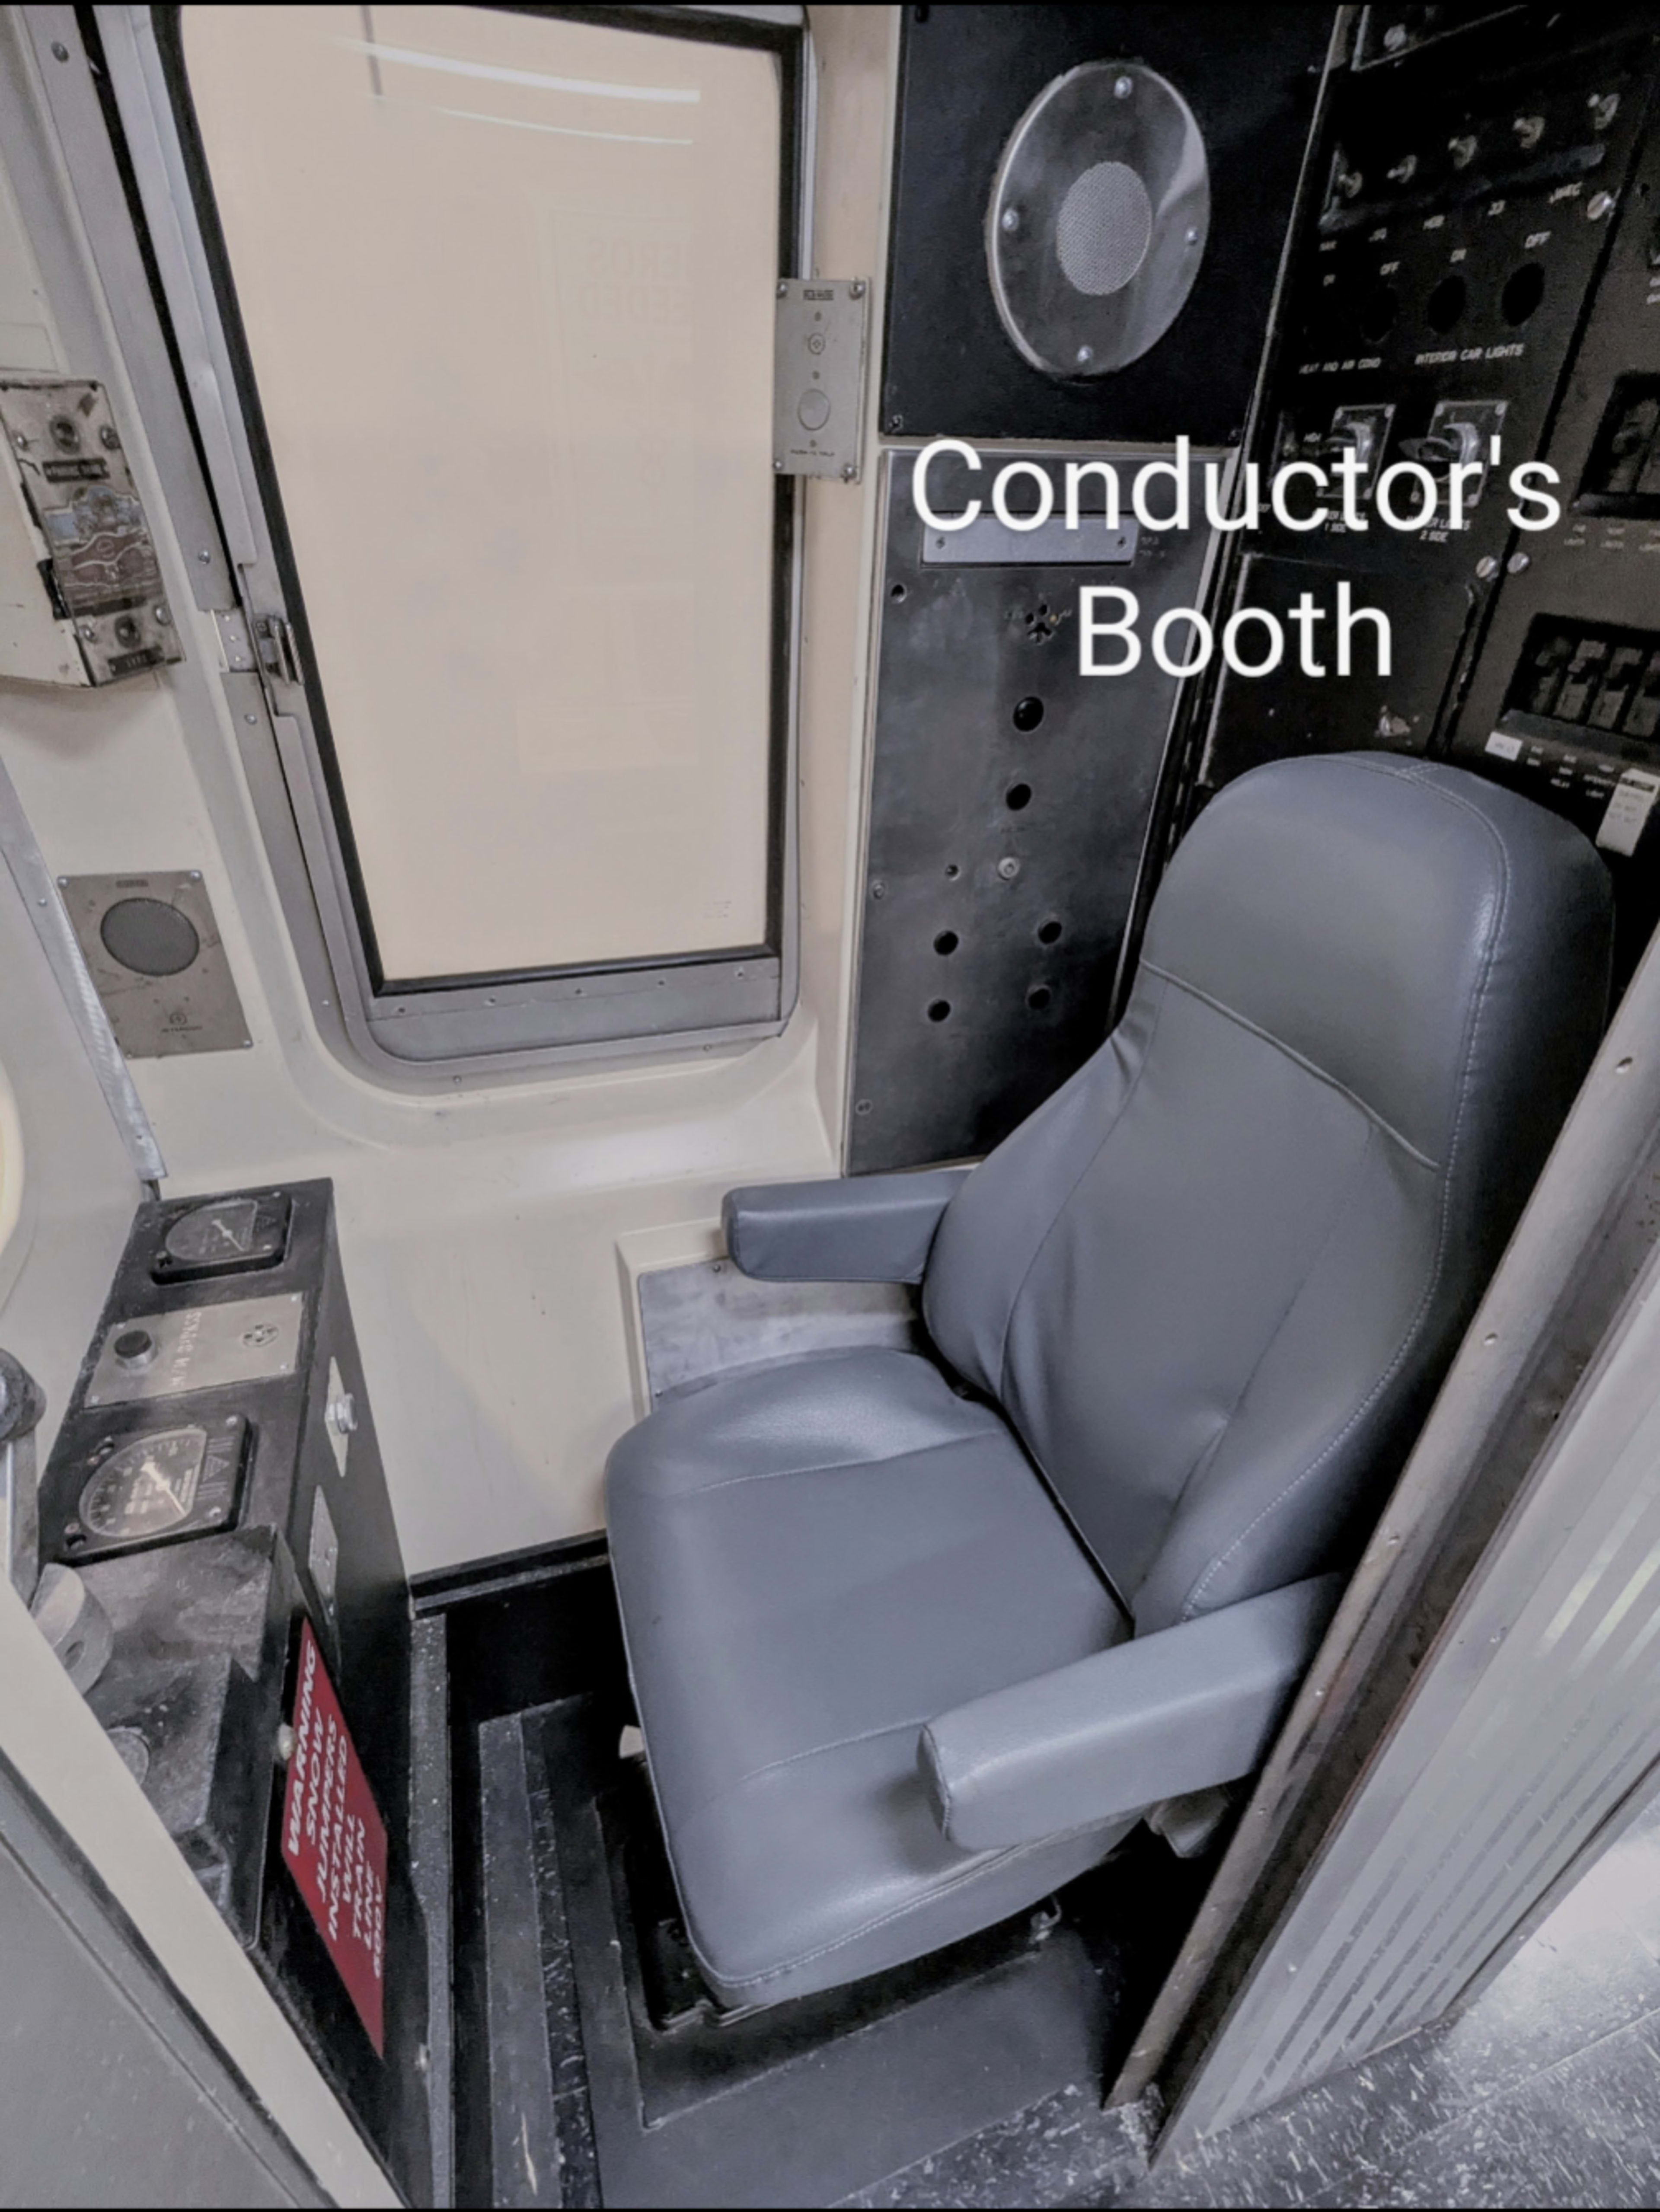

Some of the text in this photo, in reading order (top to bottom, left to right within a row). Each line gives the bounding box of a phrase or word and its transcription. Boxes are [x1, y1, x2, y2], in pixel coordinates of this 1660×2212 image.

[1415, 343, 1525, 364] INTERIOR CAR LIGHTS
[288, 1640, 316, 1856] WARNING
[306, 1706, 324, 1845] SNOW
[316, 1714, 337, 1903] JUMPERS
[328, 1735, 347, 1941] INSTALLED
[342, 1814, 356, 1903] WILL
[352, 1817, 365, 1939] TRAIN
[364, 1861, 374, 1950] LINE
